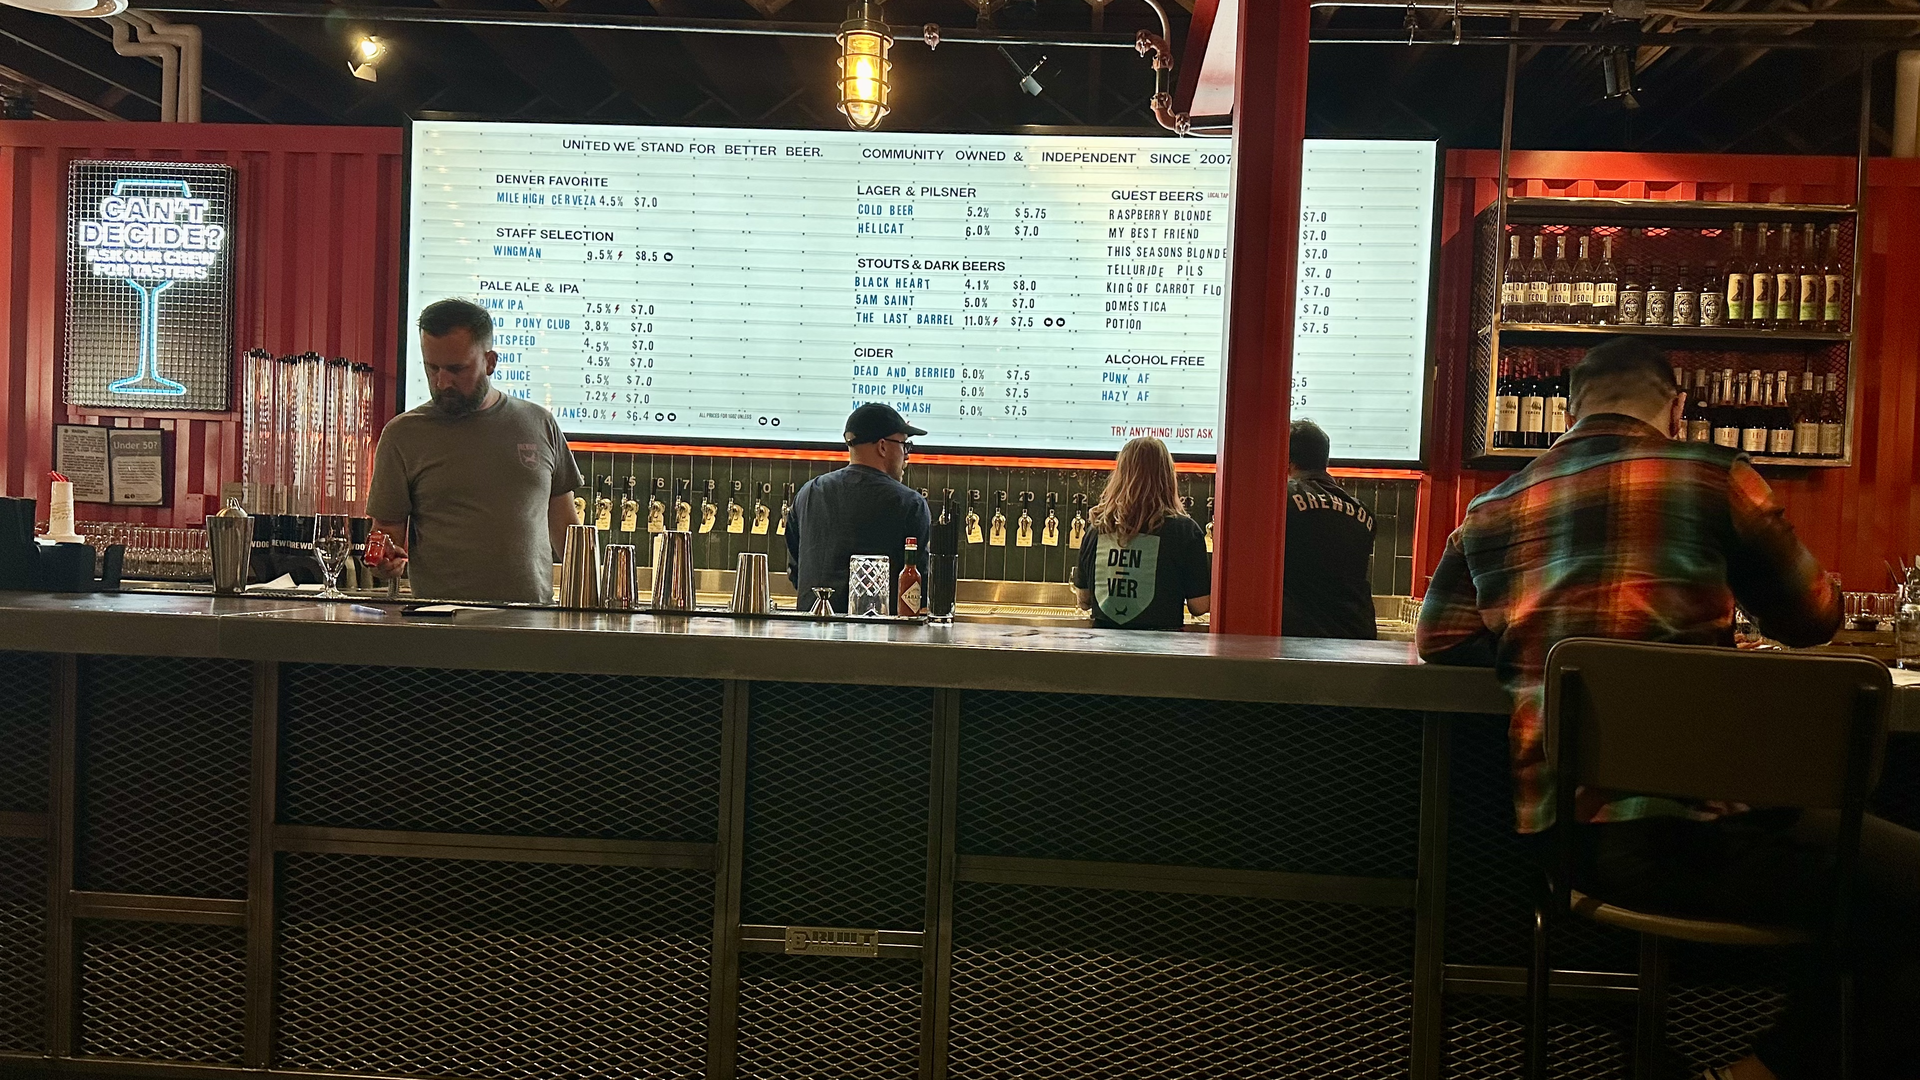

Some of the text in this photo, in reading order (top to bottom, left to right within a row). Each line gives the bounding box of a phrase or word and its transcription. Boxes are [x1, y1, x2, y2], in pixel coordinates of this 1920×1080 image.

[563, 140, 823, 157] UNITED WE STAND FOR BETTER BEER.
[863, 149, 1231, 164] COMMUNITY OWNED & INDEPENDENT SINCE 2007
[497, 175, 608, 187] DENVER FAVORITE
[858, 186, 976, 197] LAGER & PILSNER
[1112, 190, 1203, 201] GUEST BEERS
[497, 192, 657, 207] MILE HIGH CERVEZA 4.5% $7.0
[100, 197, 209, 224] CAN'T
[858, 204, 882, 215] COLD
[890, 205, 913, 215] BEER
[967, 207, 989, 218] 5.2%
[1109, 209, 1211, 221] RASPBERRY BLONDE
[1303, 212, 1326, 222] $7.0
[79, 221, 226, 250] DECIDE?
[497, 228, 613, 241] STAFF SELECTION
[858, 223, 1038, 236] HELLCAT 6.0% $7.0
[1109, 228, 1198, 239] MY BEST FRIEND
[1303, 230, 1326, 240] $7.0
[87, 249, 216, 265] ASK OUR CREW
[494, 246, 657, 261] WINGMAN 9.5% $8.5
[1108, 246, 1227, 259] THIS SEASONS BLONDE
[1305, 249, 1327, 259] $7.0
[858, 259, 1005, 271] STOUTS & DARK BEERS
[1108, 264, 1202, 277] TELLURIDE PILS
[481, 281, 579, 293] PALE ALE & IPA
[855, 277, 1036, 291] BLACK HEART 4.1% $8.0
[1137, 283, 1148, 293] OF
[1156, 283, 1194, 294] CARROT
[1304, 286, 1330, 297] $7.0
[508, 300, 523, 310] IPA
[587, 303, 611, 313] 7.5%
[631, 305, 654, 315] $7.0
[856, 295, 1034, 308] 5AM SAINT 5.0% $7.0
[1304, 304, 1329, 316] $7.0
[516, 318, 652, 333] PONY CLUB 3.8% $7.0
[857, 312, 1033, 327] THE LAST BARREL 11.0% $7.5
[632, 340, 653, 350] $7.0
[855, 348, 893, 358] CIDER
[587, 356, 653, 368] 4.5% $7.0
[1105, 355, 1204, 366] ALCOHOL FREE
[506, 371, 530, 380] JUICE
[585, 374, 609, 385] 6.5%
[627, 376, 652, 386] $7.0
[854, 366, 1029, 380] DEAD AND BERRIED 6.0% $7.5
[1103, 372, 1149, 384] PUNK AF
[586, 391, 649, 404] 7.2% $7.0
[852, 384, 1028, 398] TROPIC PUNCH 6.0% $7.5
[1102, 391, 1149, 402] HAZY AF
[896, 402, 930, 413] SMASH
[960, 406, 982, 416] 6.0%
[1005, 406, 1027, 416] $7.5
[627, 411, 648, 421] $6.4
[1111, 427, 1213, 438] TRY ANYTHING! JUST ASK
[113, 441, 158, 450] Under 50?
[1292, 491, 1373, 532] BREWDOG
[1107, 548, 1142, 569] DEN
[1107, 577, 1138, 599] VER
